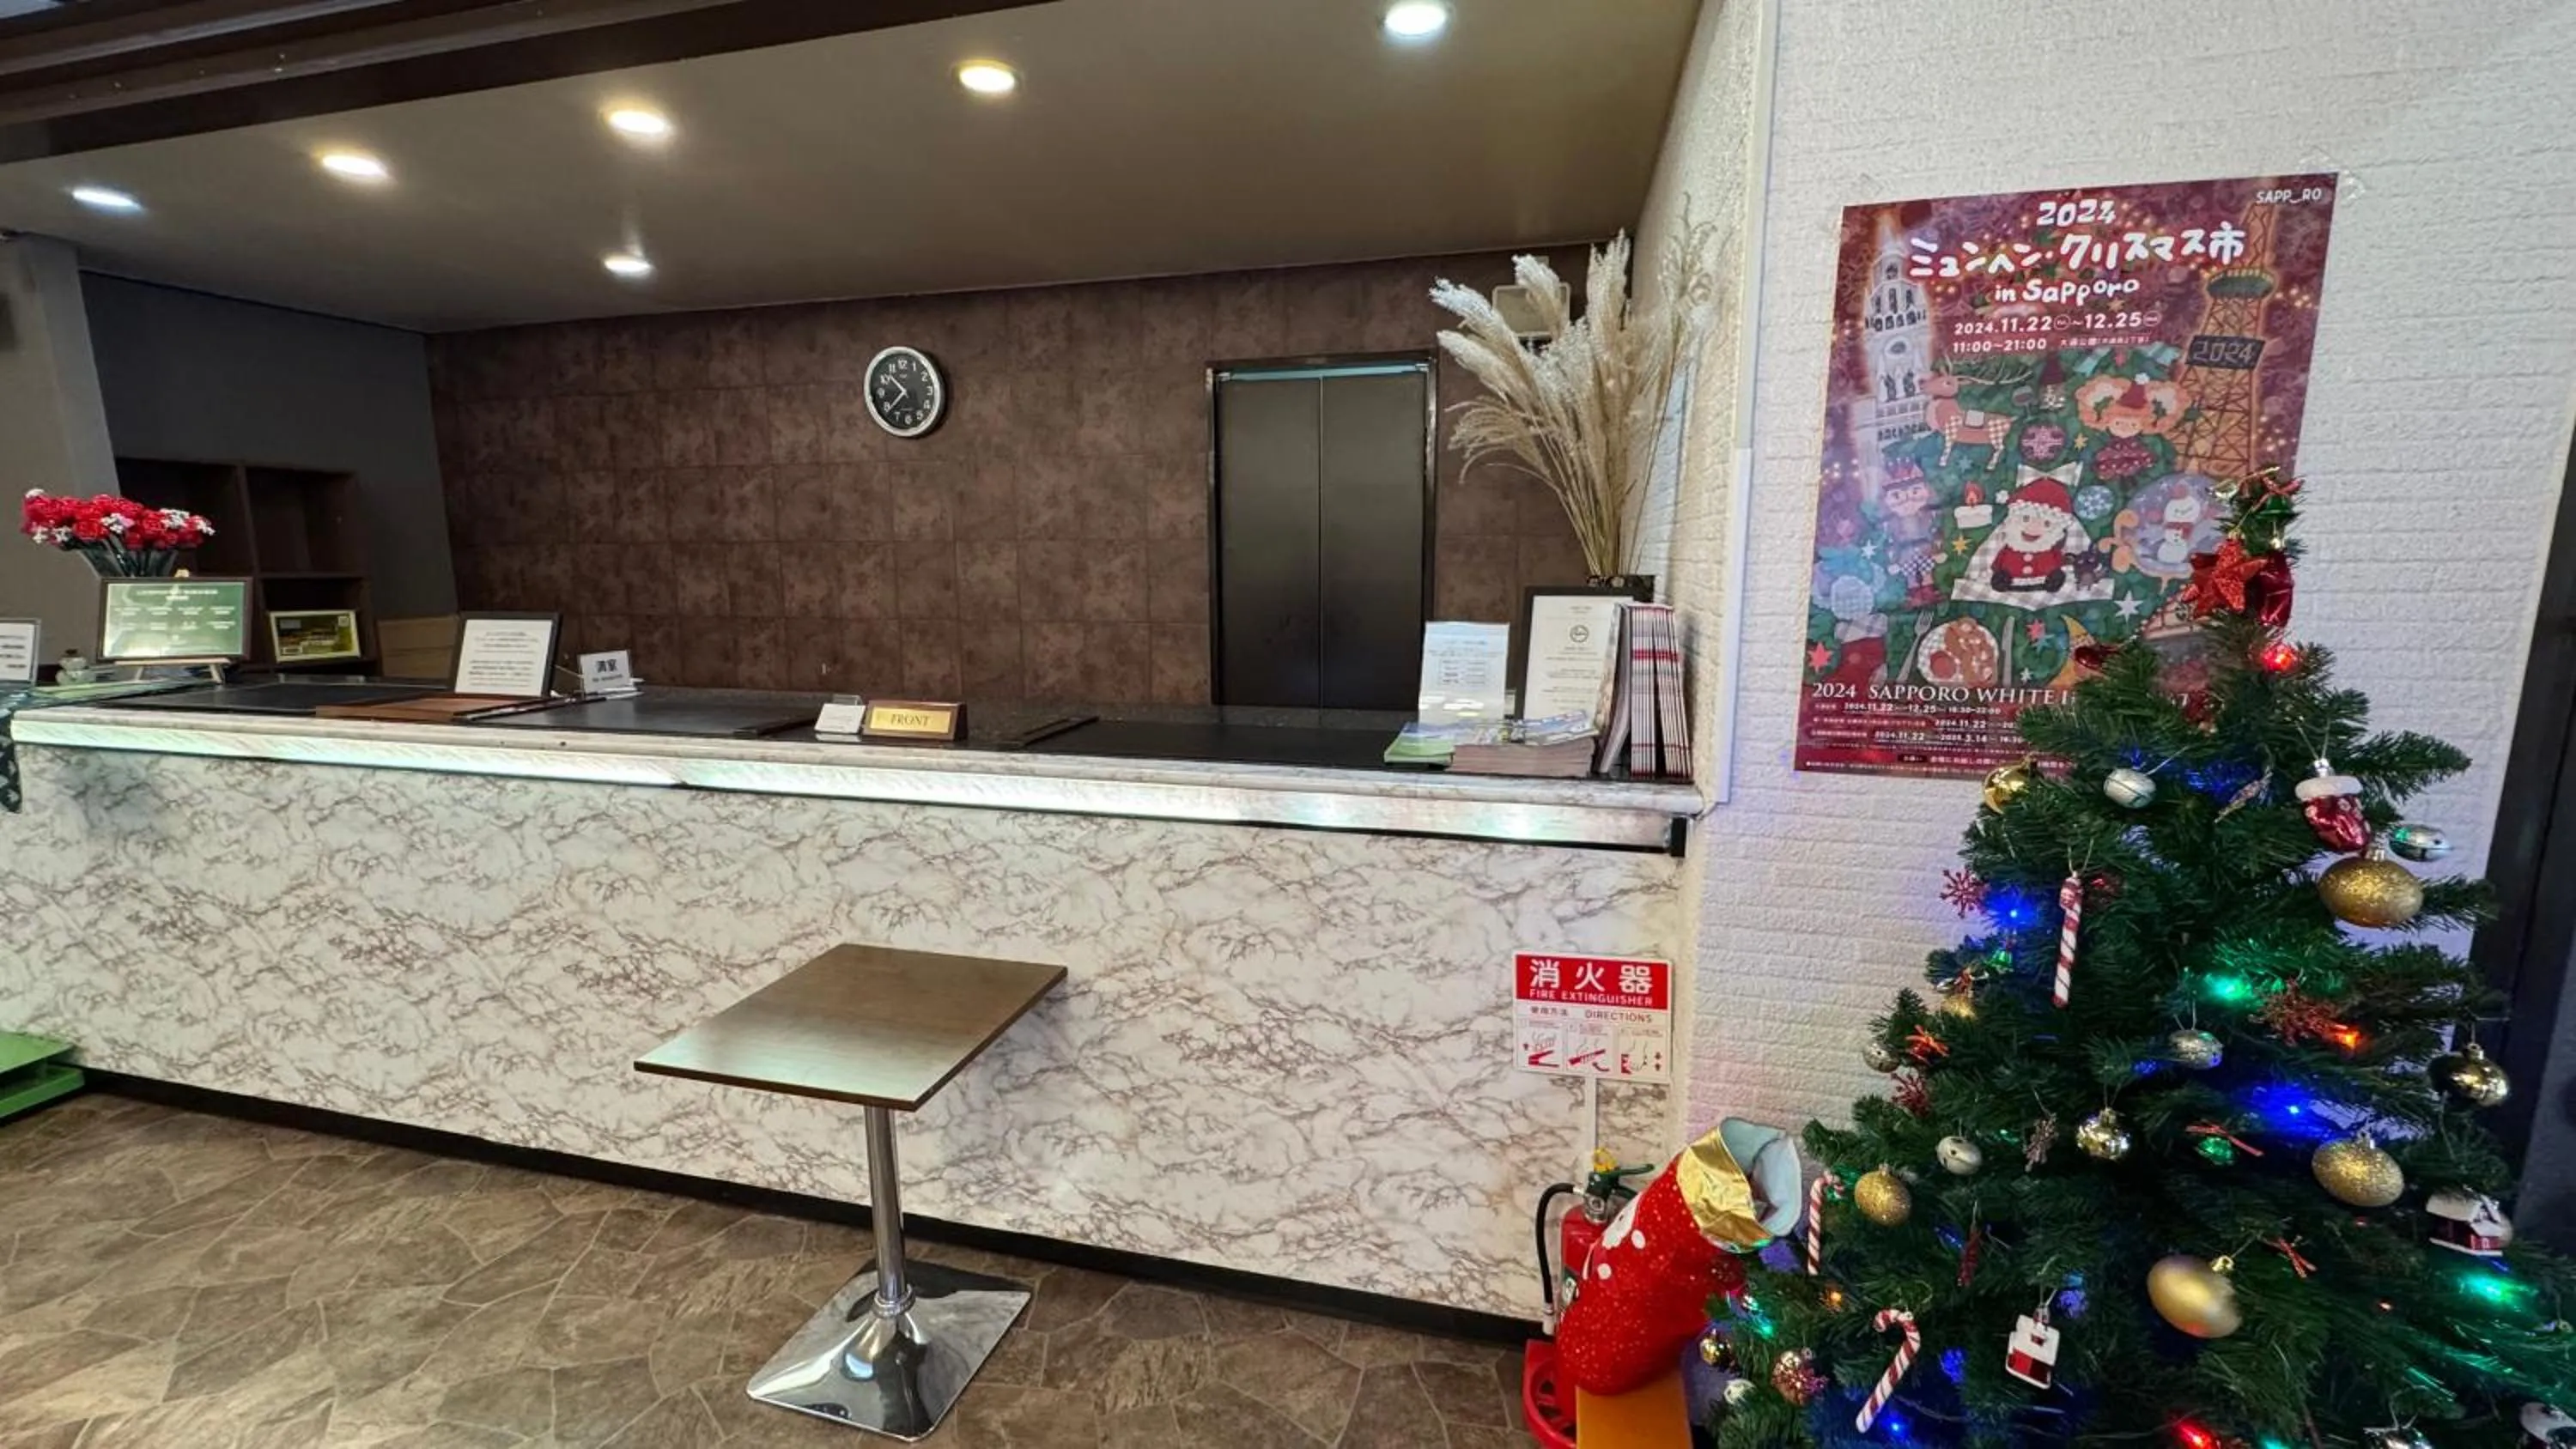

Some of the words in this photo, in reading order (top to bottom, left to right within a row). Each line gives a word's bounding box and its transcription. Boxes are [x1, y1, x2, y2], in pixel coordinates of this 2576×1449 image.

[2037, 198, 2116, 227] 2024
[1995, 284, 2016, 302] in
[2022, 279, 2141, 306] Sapporo
[2193, 341, 2253, 364] 2024
[1813, 682, 1856, 698] 2024
[1868, 684, 1969, 702] SAPPORO
[1977, 688, 2055, 705] WHITE
[890, 713, 931, 727] FRONT
[1530, 958, 1653, 994] 消火器
[1529, 988, 1556, 1000] FIRE
[1561, 991, 1654, 1006] EXTINGUISHER
[1584, 1009, 1653, 1024] DIRECTIONS
